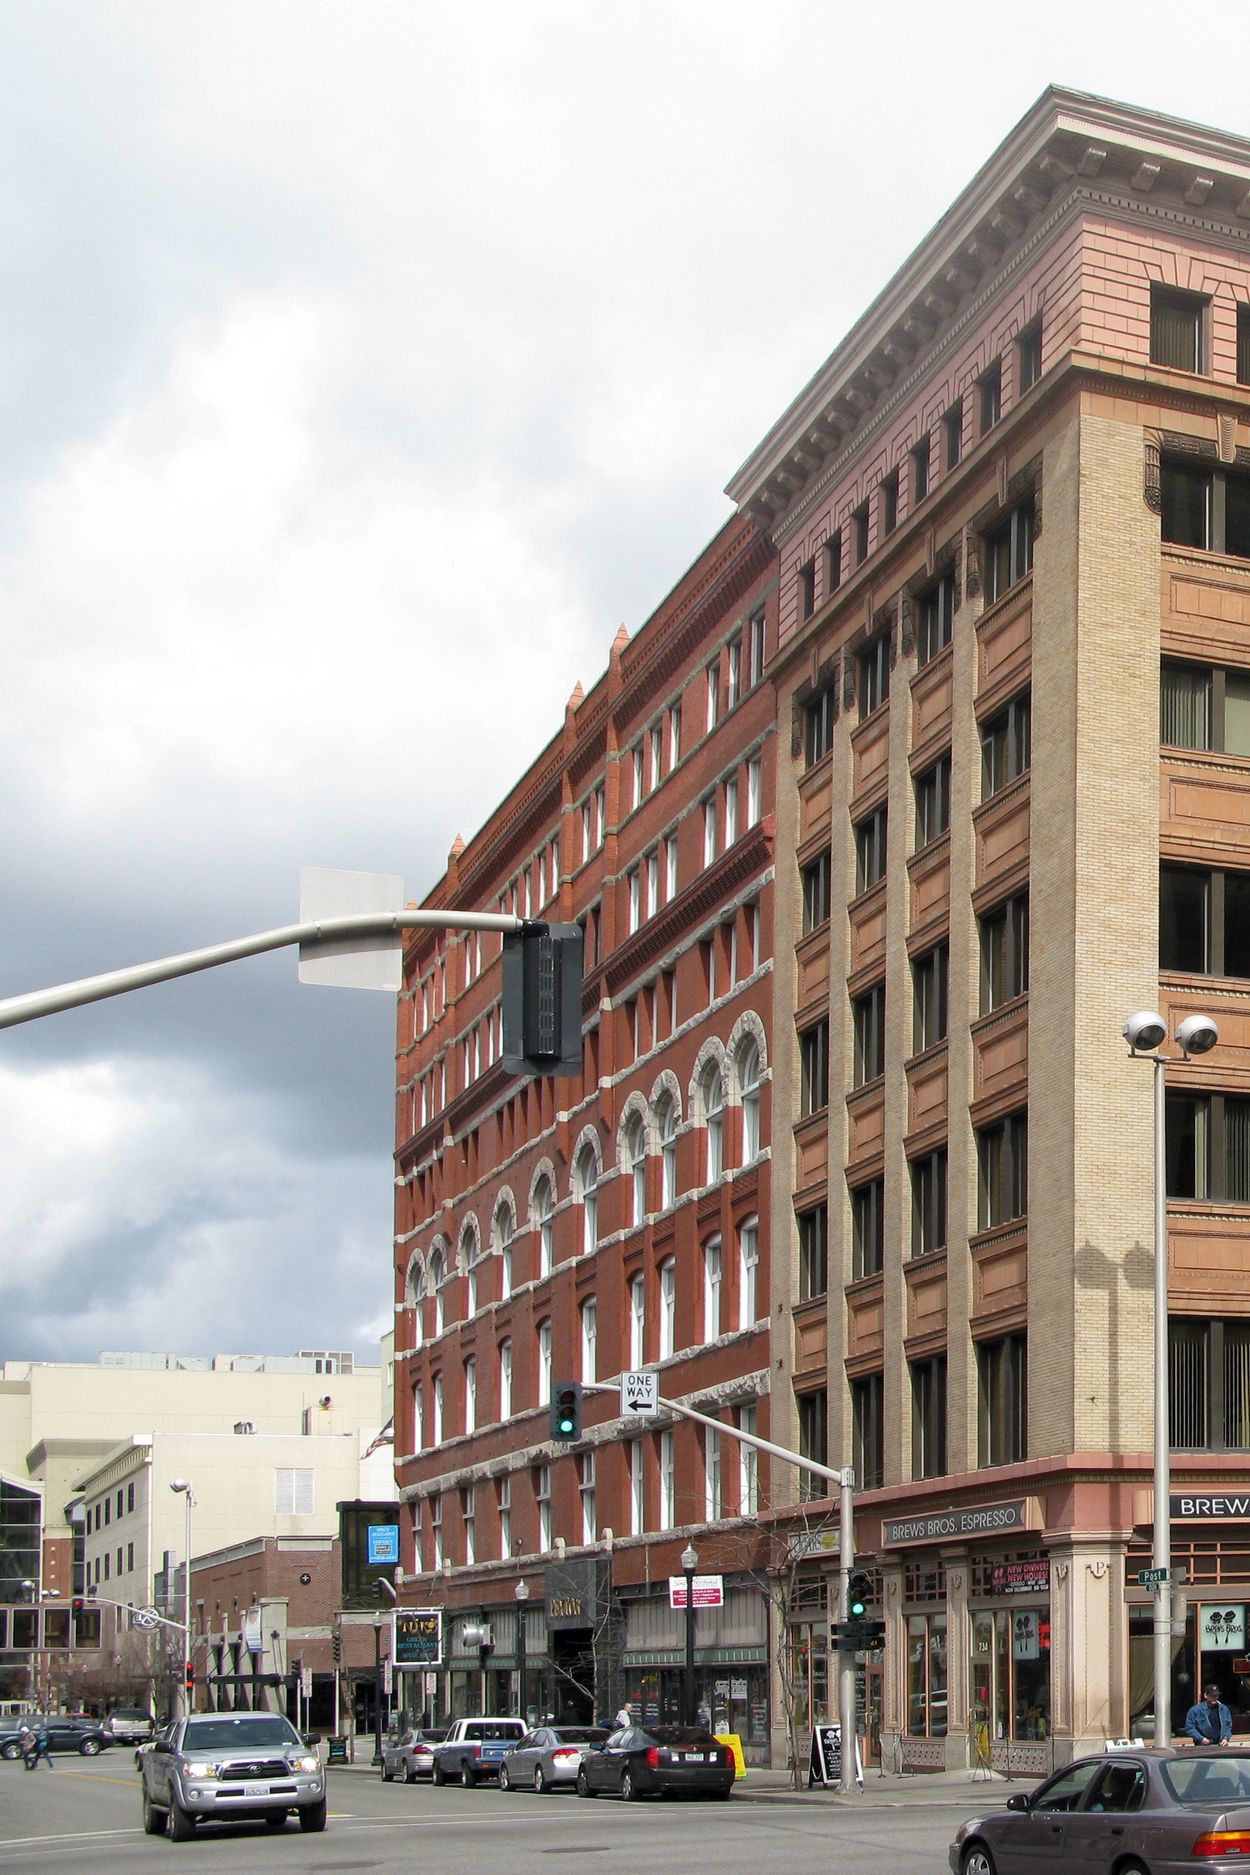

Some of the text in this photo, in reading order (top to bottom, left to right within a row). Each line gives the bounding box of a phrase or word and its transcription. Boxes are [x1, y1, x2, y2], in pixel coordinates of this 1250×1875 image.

[627, 1375, 652, 1386] ONE
[626, 1387, 652, 1398] WAY
[892, 1508, 1016, 1540] BREWS BROS. ESPRESSO
[1007, 1565, 1022, 1573] NEW
[1007, 1571, 1048, 1582] NEW HOURS!
[1144, 1571, 1162, 1582] Post
[979, 1642, 988, 1651] 734
